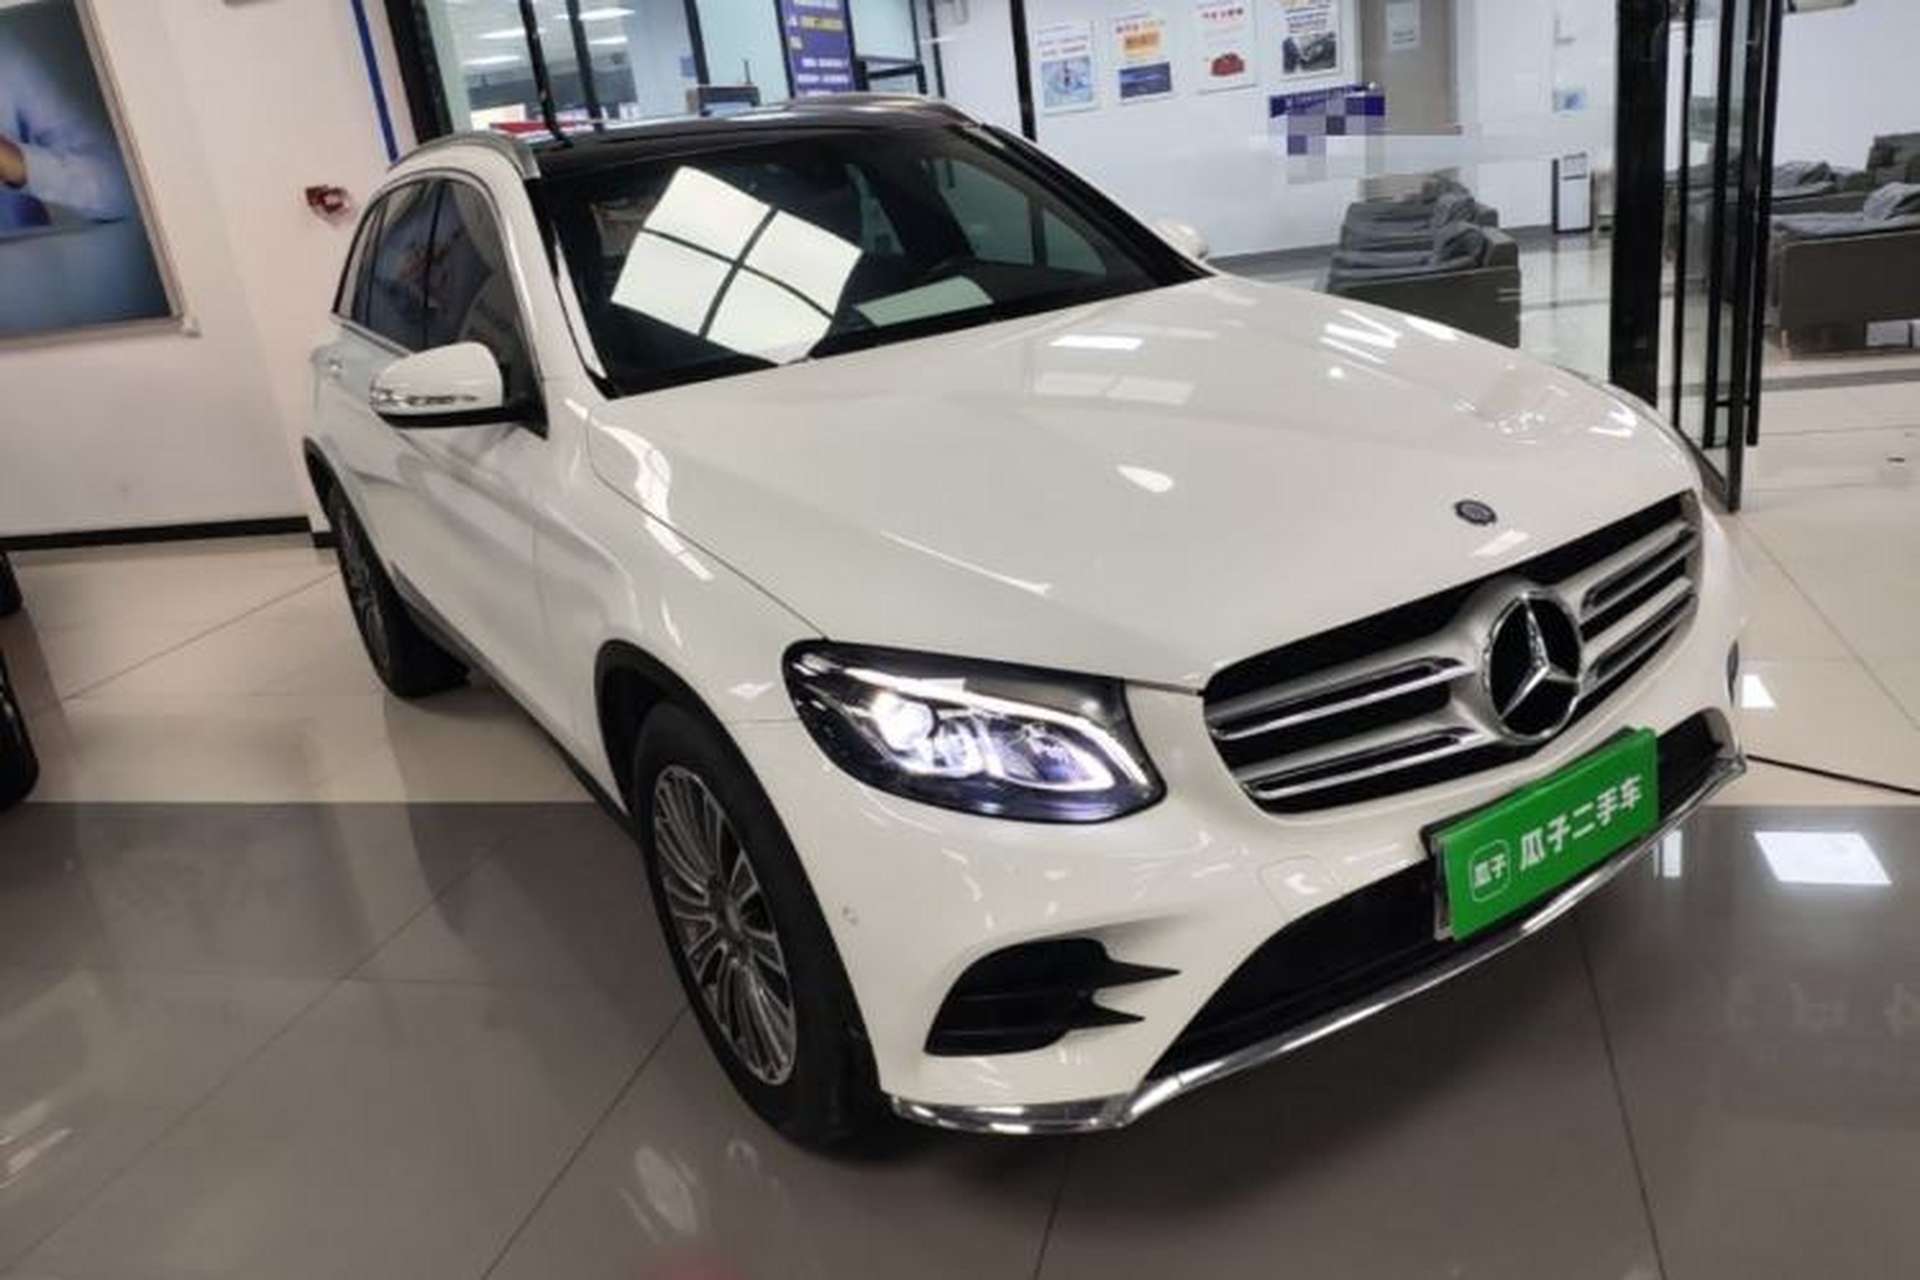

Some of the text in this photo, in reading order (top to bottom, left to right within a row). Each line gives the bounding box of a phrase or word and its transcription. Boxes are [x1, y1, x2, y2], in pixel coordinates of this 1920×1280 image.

[1519, 774, 1642, 871] 瓜子二手车
